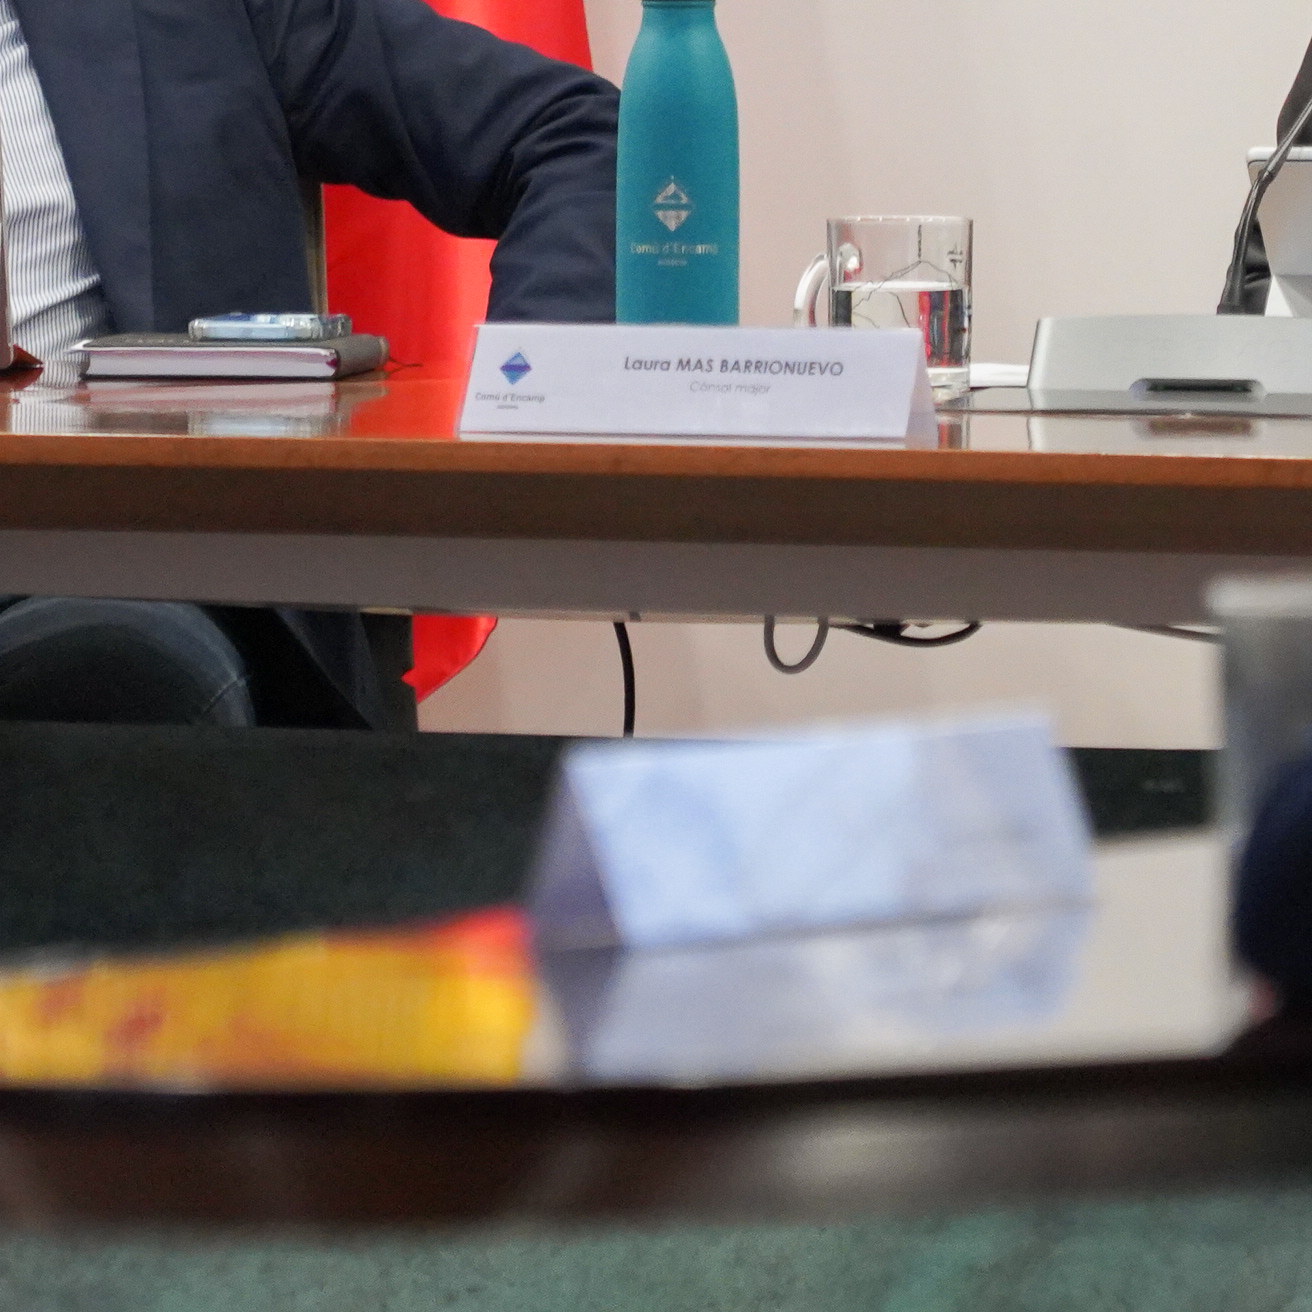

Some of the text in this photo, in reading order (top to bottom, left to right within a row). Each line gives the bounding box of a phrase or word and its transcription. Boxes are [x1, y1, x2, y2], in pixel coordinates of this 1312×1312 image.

[624, 356, 845, 377] Laura MAS BARRIONUEVO
